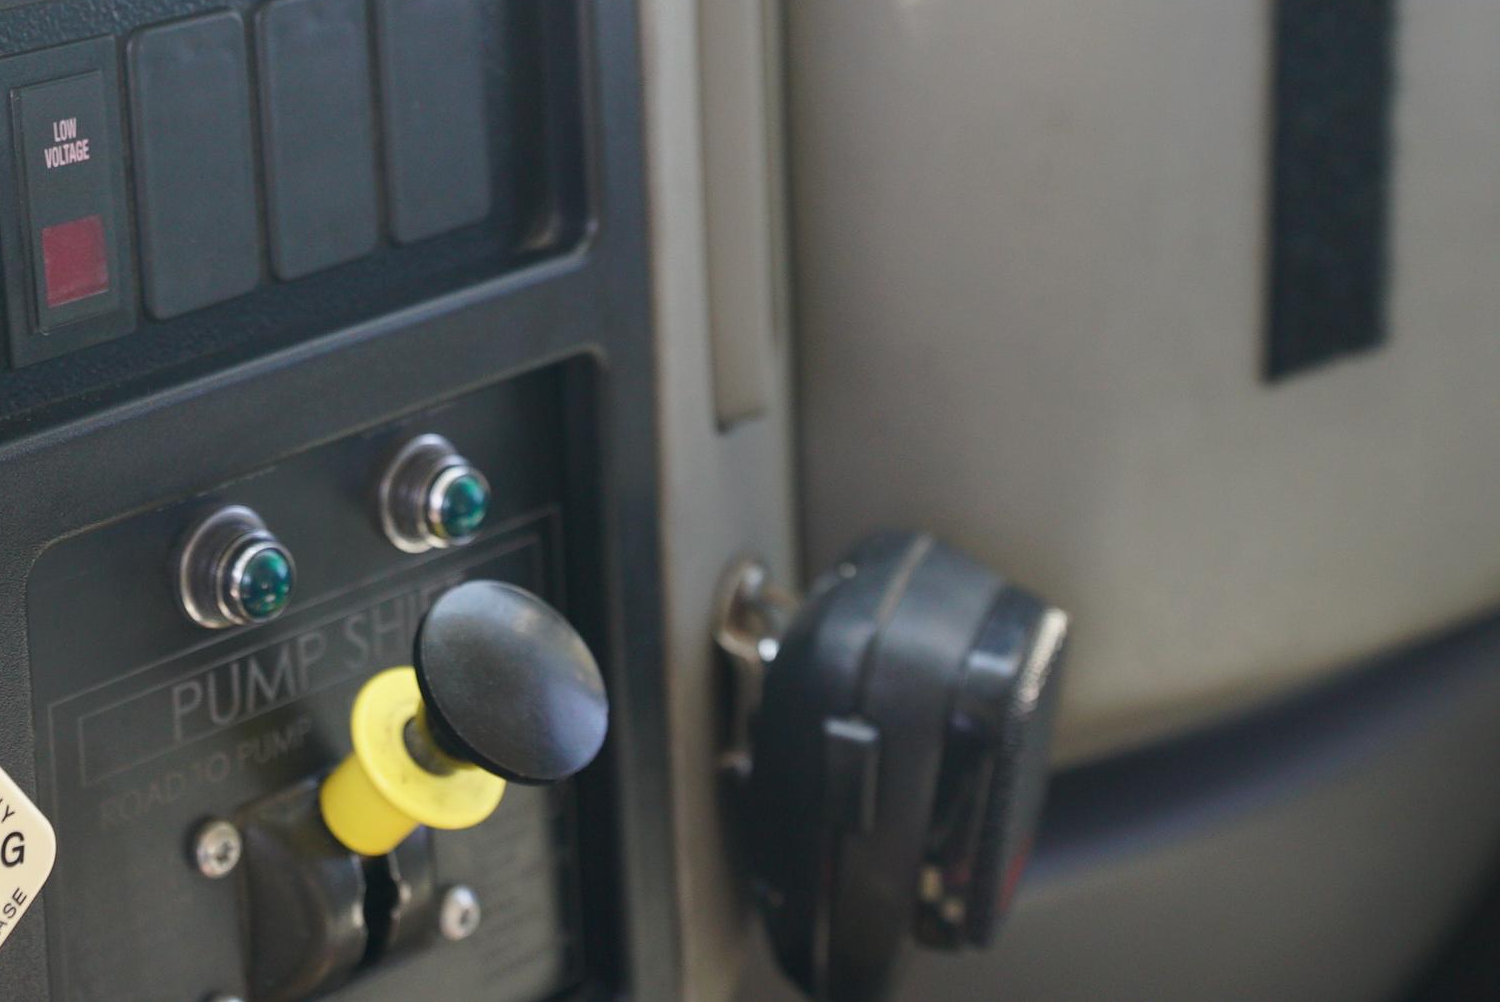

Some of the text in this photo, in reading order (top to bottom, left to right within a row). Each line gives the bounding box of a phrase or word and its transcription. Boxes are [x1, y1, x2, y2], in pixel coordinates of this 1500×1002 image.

[53, 117, 77, 143] LOW
[43, 138, 90, 169] VOLTAGE
[170, 632, 328, 741] PUMP
